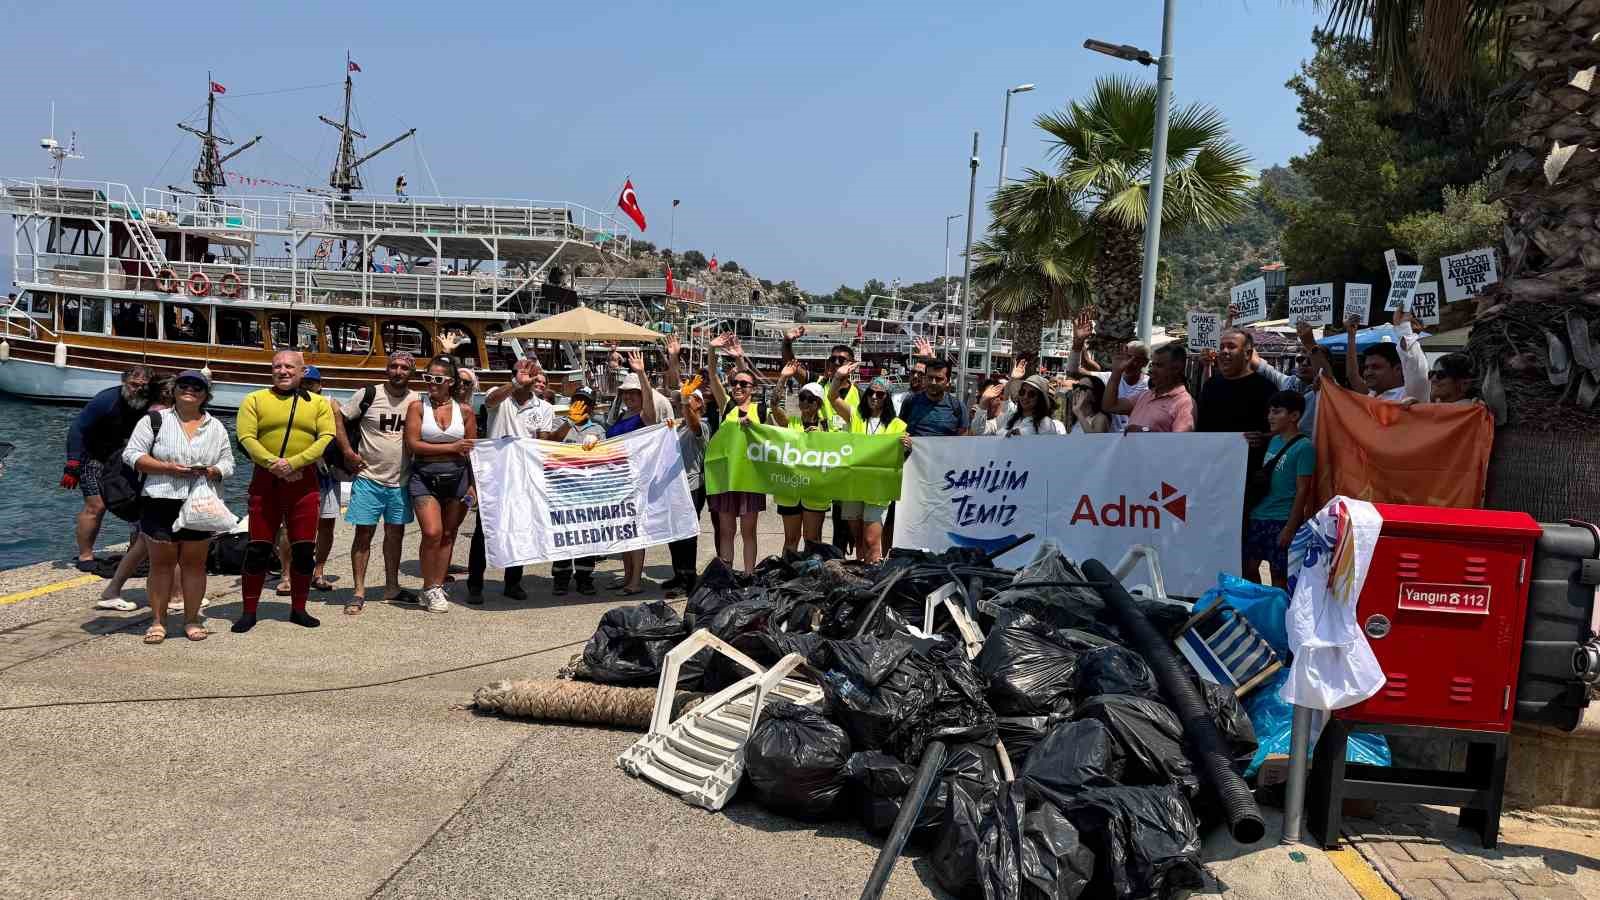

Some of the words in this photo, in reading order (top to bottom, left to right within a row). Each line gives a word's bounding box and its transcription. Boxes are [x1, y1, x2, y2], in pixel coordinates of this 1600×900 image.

[1447, 254, 1488, 267] karbon
[1455, 273, 1486, 287] DENK
[1242, 288, 1257, 299] AM
[1300, 287, 1321, 297] geri
[1413, 292, 1437, 306] IFIR
[1191, 314, 1217, 324] CHANGE
[1191, 338, 1217, 347] CLIMATE
[549, 501, 637, 526] MARMARİS
[1069, 495, 1160, 529] Adm
[553, 521, 639, 548] BELEDİYESİ
[1462, 594, 1485, 607] 112
